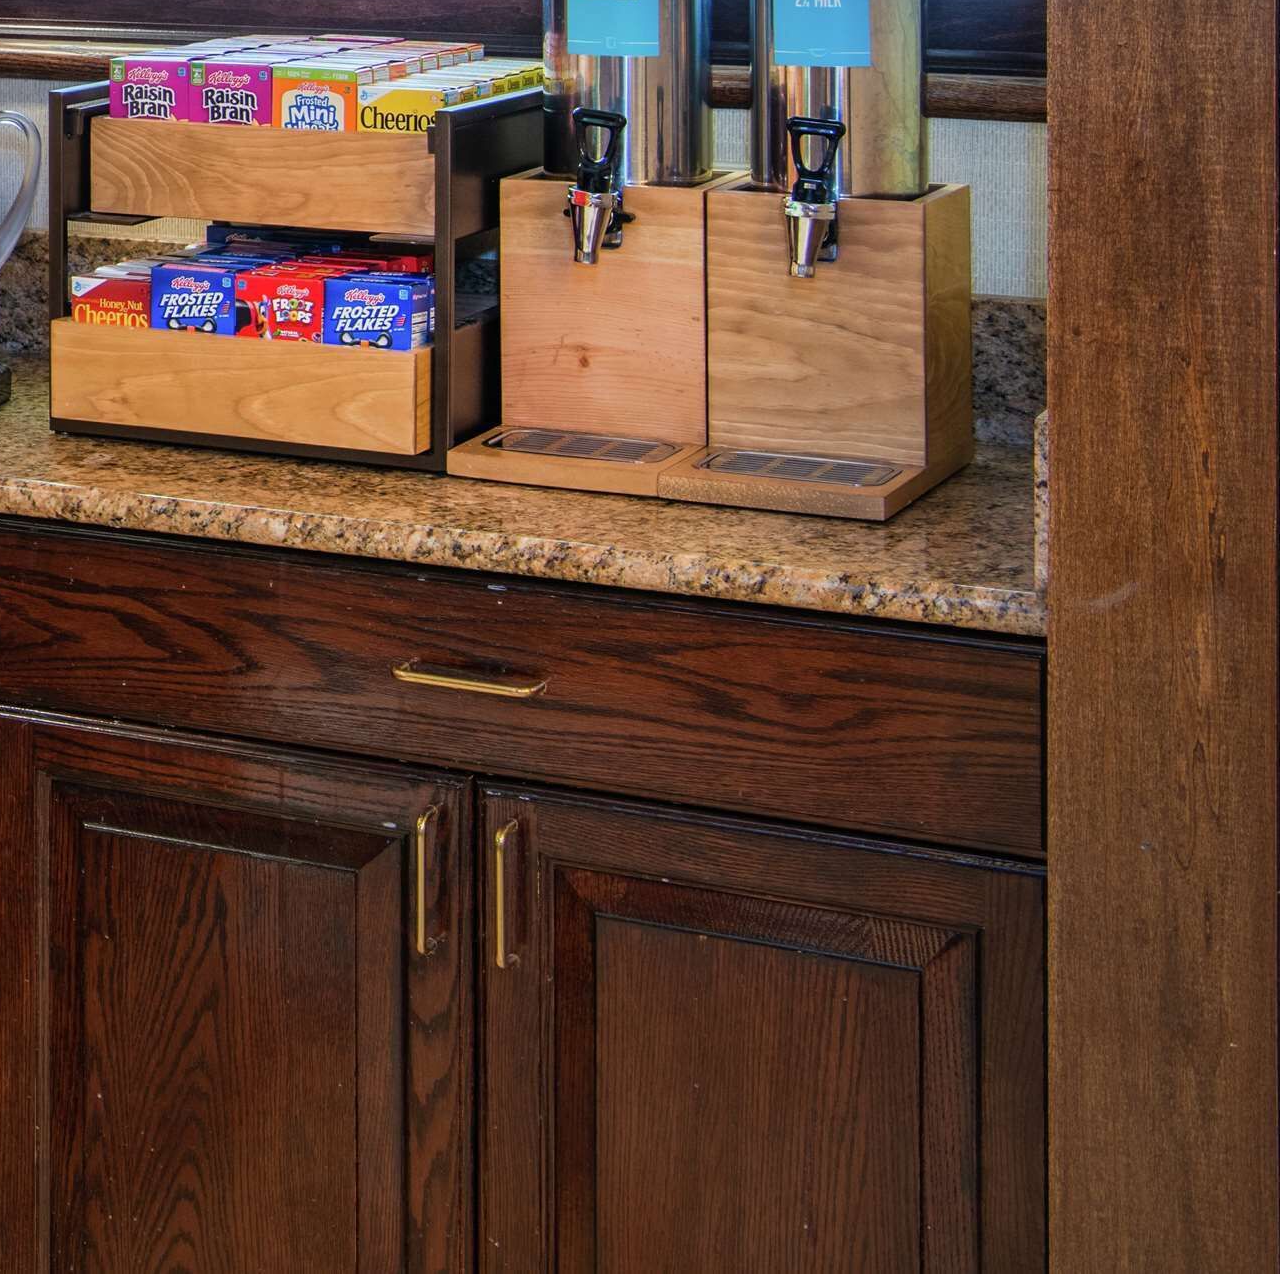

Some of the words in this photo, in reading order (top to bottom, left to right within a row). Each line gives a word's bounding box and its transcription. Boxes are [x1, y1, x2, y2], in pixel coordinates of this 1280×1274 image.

[128, 65, 170, 84] Kellogg's
[208, 69, 251, 88] Kellogg's
[123, 84, 176, 106] Raisin
[203, 87, 258, 110] Raisin
[295, 95, 330, 108] Frosted
[129, 101, 171, 119] Bran
[209, 104, 252, 123] Bran
[289, 105, 336, 126] Mini
[171, 276, 211, 293] Kellogg's
[100, 298, 126, 312] Honey
[127, 300, 144, 311] Nut
[160, 291, 224, 307] FROSTED
[272, 298, 314, 312] FROOT
[344, 288, 386, 306] Kellogg's
[74, 303, 149, 328] Cheerios
[163, 304, 217, 319] FLAKES
[275, 309, 313, 324] LOOPS
[332, 304, 400, 320] FROSTED
[335, 317, 393, 332] FLAKES
